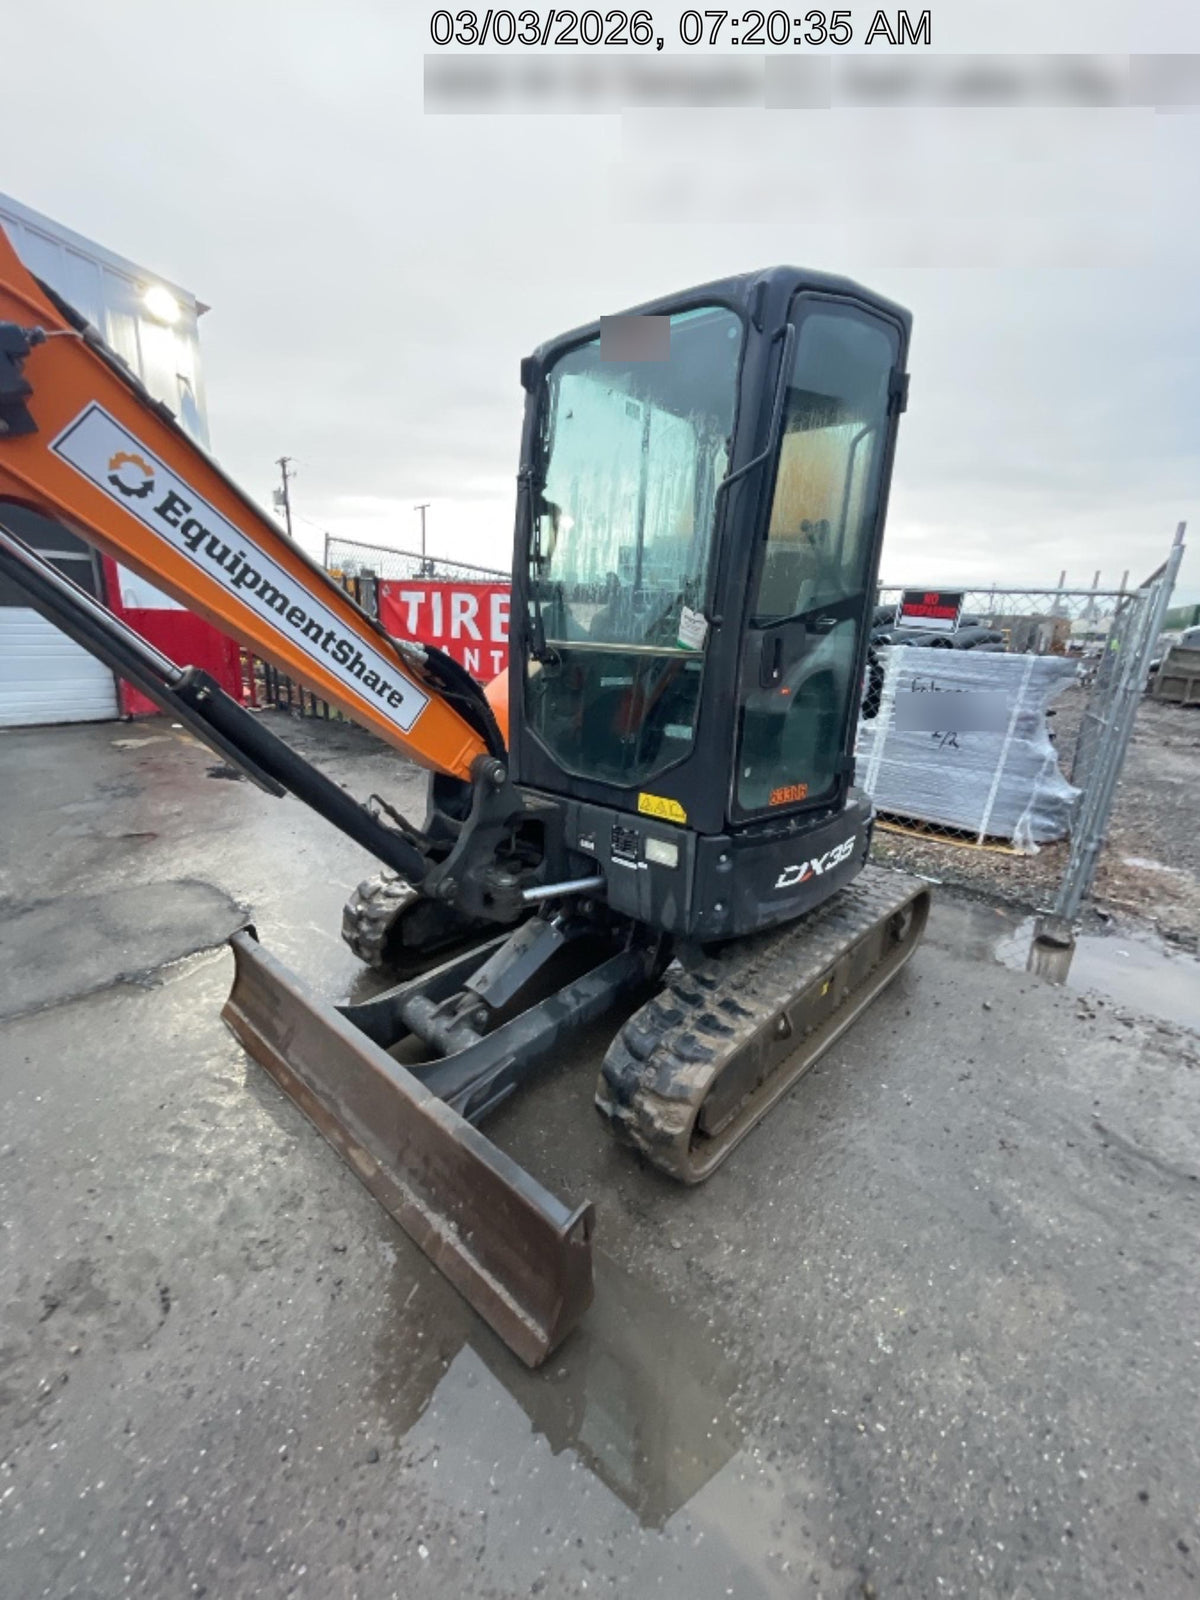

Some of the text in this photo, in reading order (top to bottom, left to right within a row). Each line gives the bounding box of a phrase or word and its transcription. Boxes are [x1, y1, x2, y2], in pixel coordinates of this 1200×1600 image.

[153, 490, 405, 710] EquipmentShare
[923, 591, 940, 605] NO
[775, 835, 857, 888] DX35
